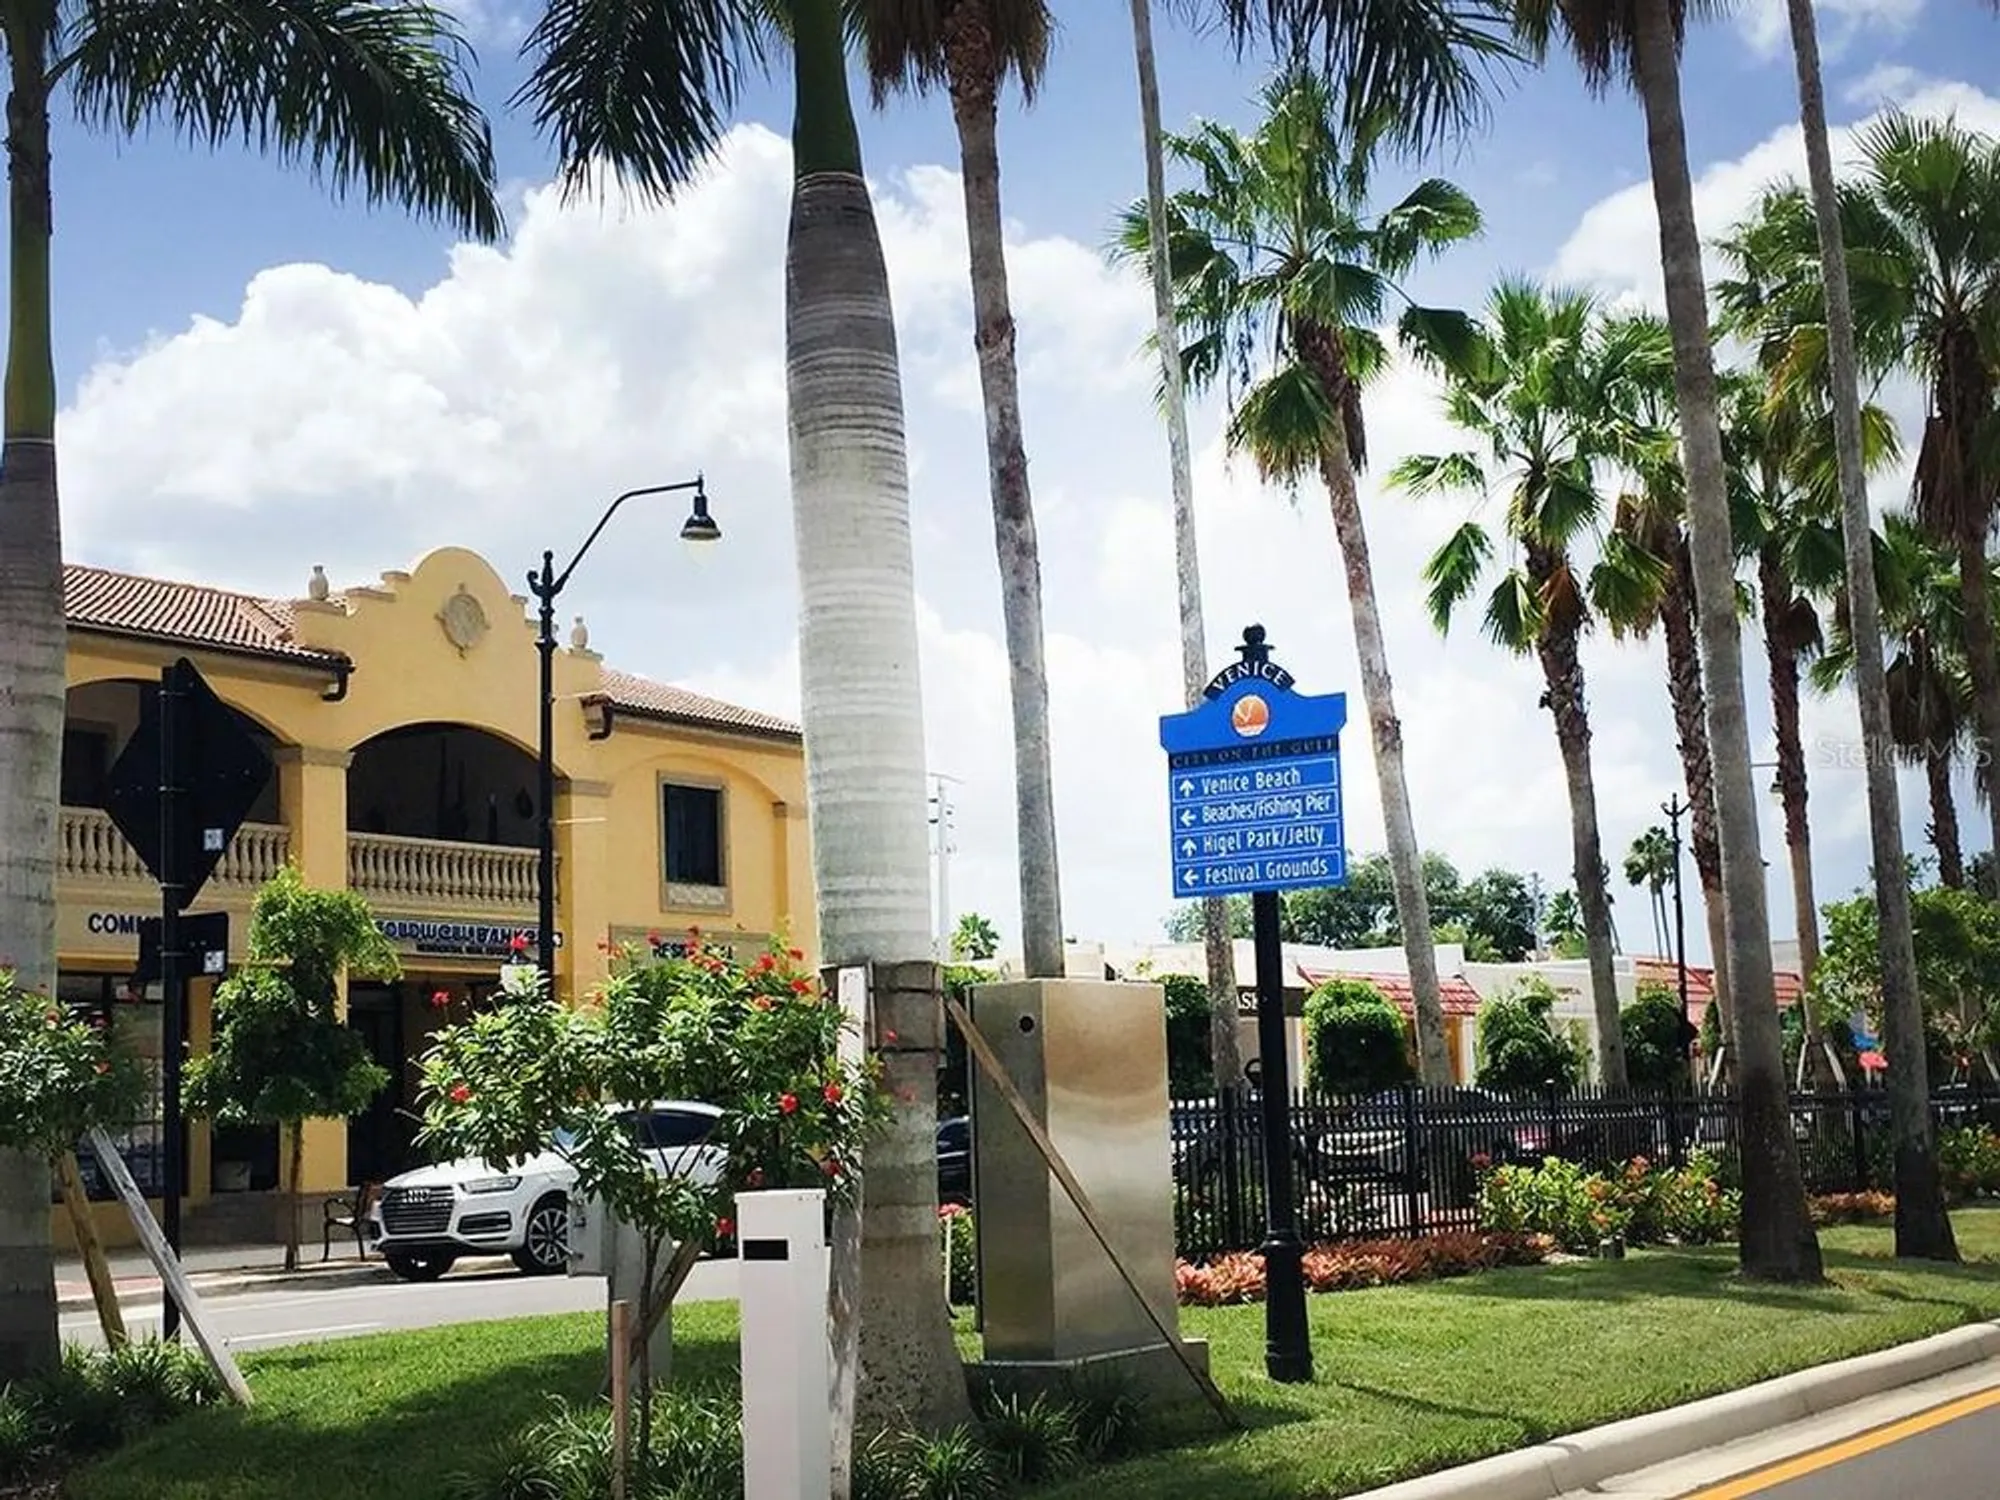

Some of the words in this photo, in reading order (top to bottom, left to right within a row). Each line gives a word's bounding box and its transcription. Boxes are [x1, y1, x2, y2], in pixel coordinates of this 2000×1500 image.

[1212, 661, 1287, 690] VENICE
[1172, 753, 1210, 768] CITY
[1218, 747, 1242, 762] ON
[1251, 743, 1281, 758] THE
[1290, 738, 1333, 754] GULF
[1201, 775, 1249, 795] Venice
[1255, 767, 1301, 790] Beach
[1202, 795, 1302, 823] Beaches/Fishing
[1305, 791, 1331, 812] Pier
[1203, 831, 1241, 857] Higel
[1247, 824, 1324, 848] Park/Jetty
[1204, 862, 1260, 885] Festival
[1265, 857, 1329, 878] Grounds
